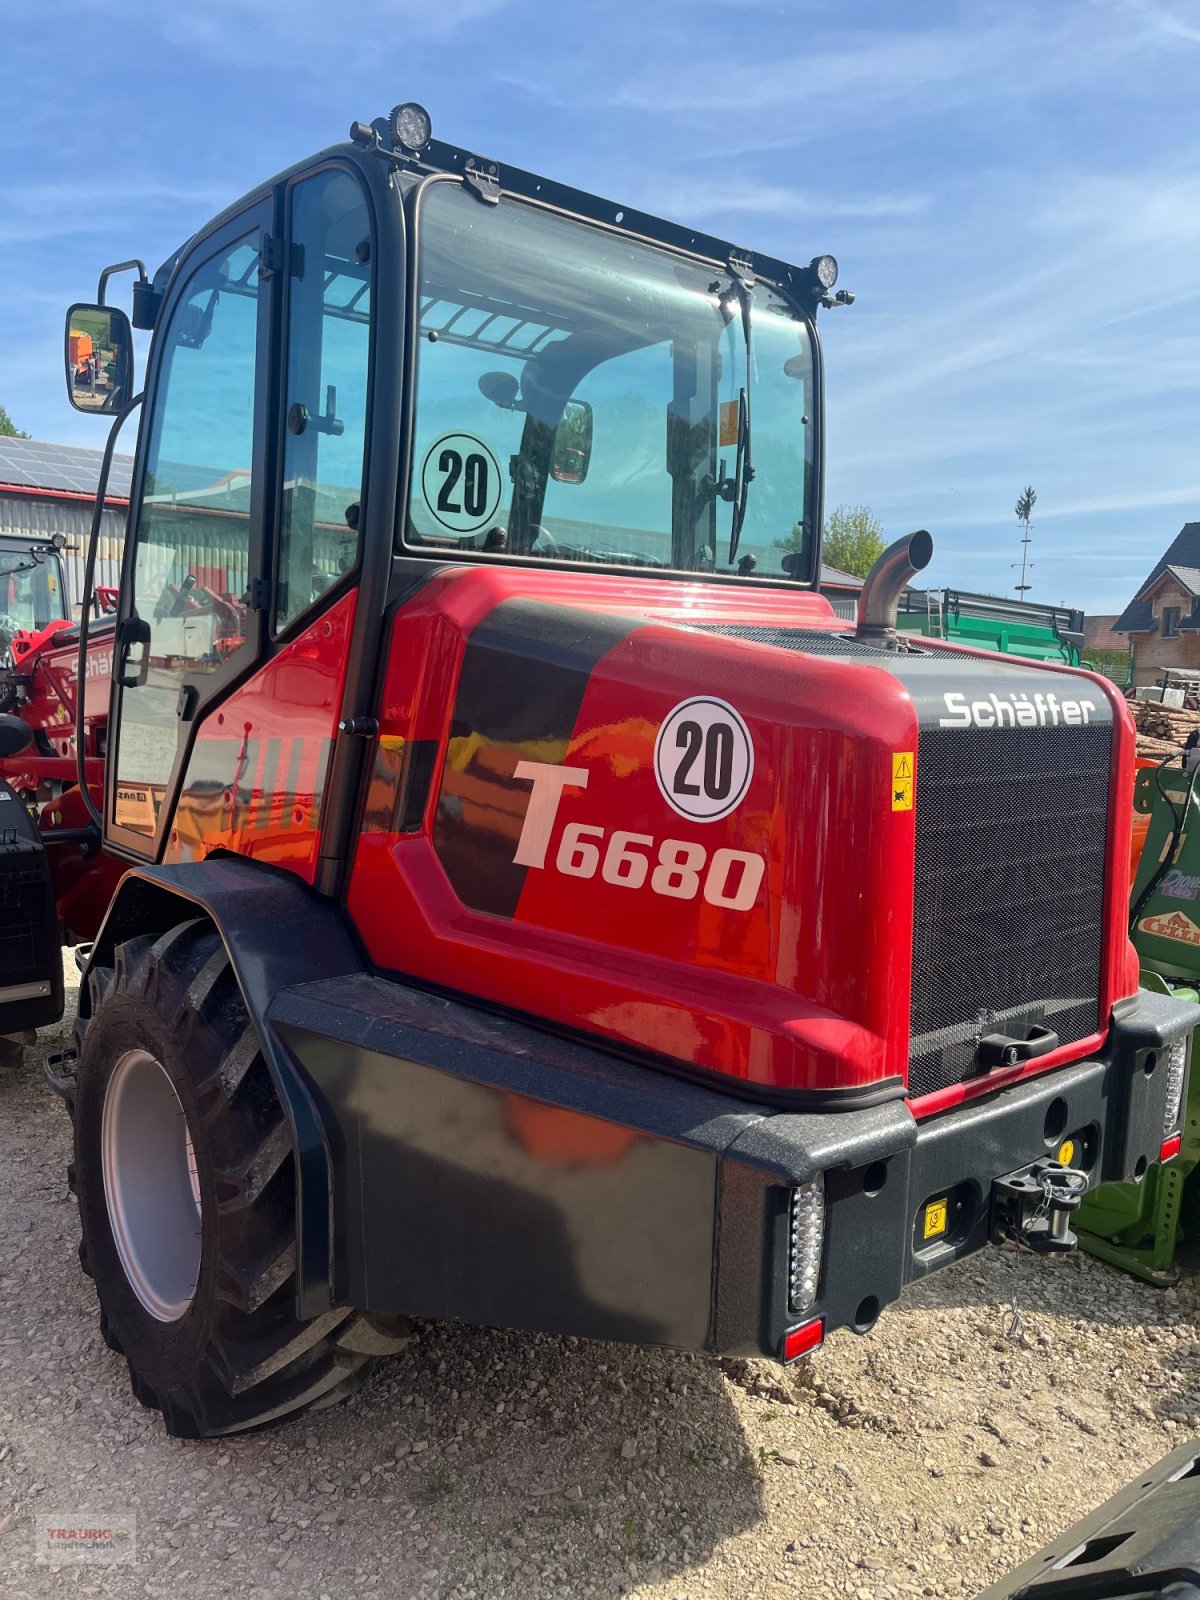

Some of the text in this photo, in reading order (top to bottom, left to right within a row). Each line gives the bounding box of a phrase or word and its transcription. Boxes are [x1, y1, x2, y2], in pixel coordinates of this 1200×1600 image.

[437, 449, 488, 517] 20
[939, 692, 1096, 728] Schäffer
[673, 720, 734, 801] 20
[512, 760, 766, 912] T6680
